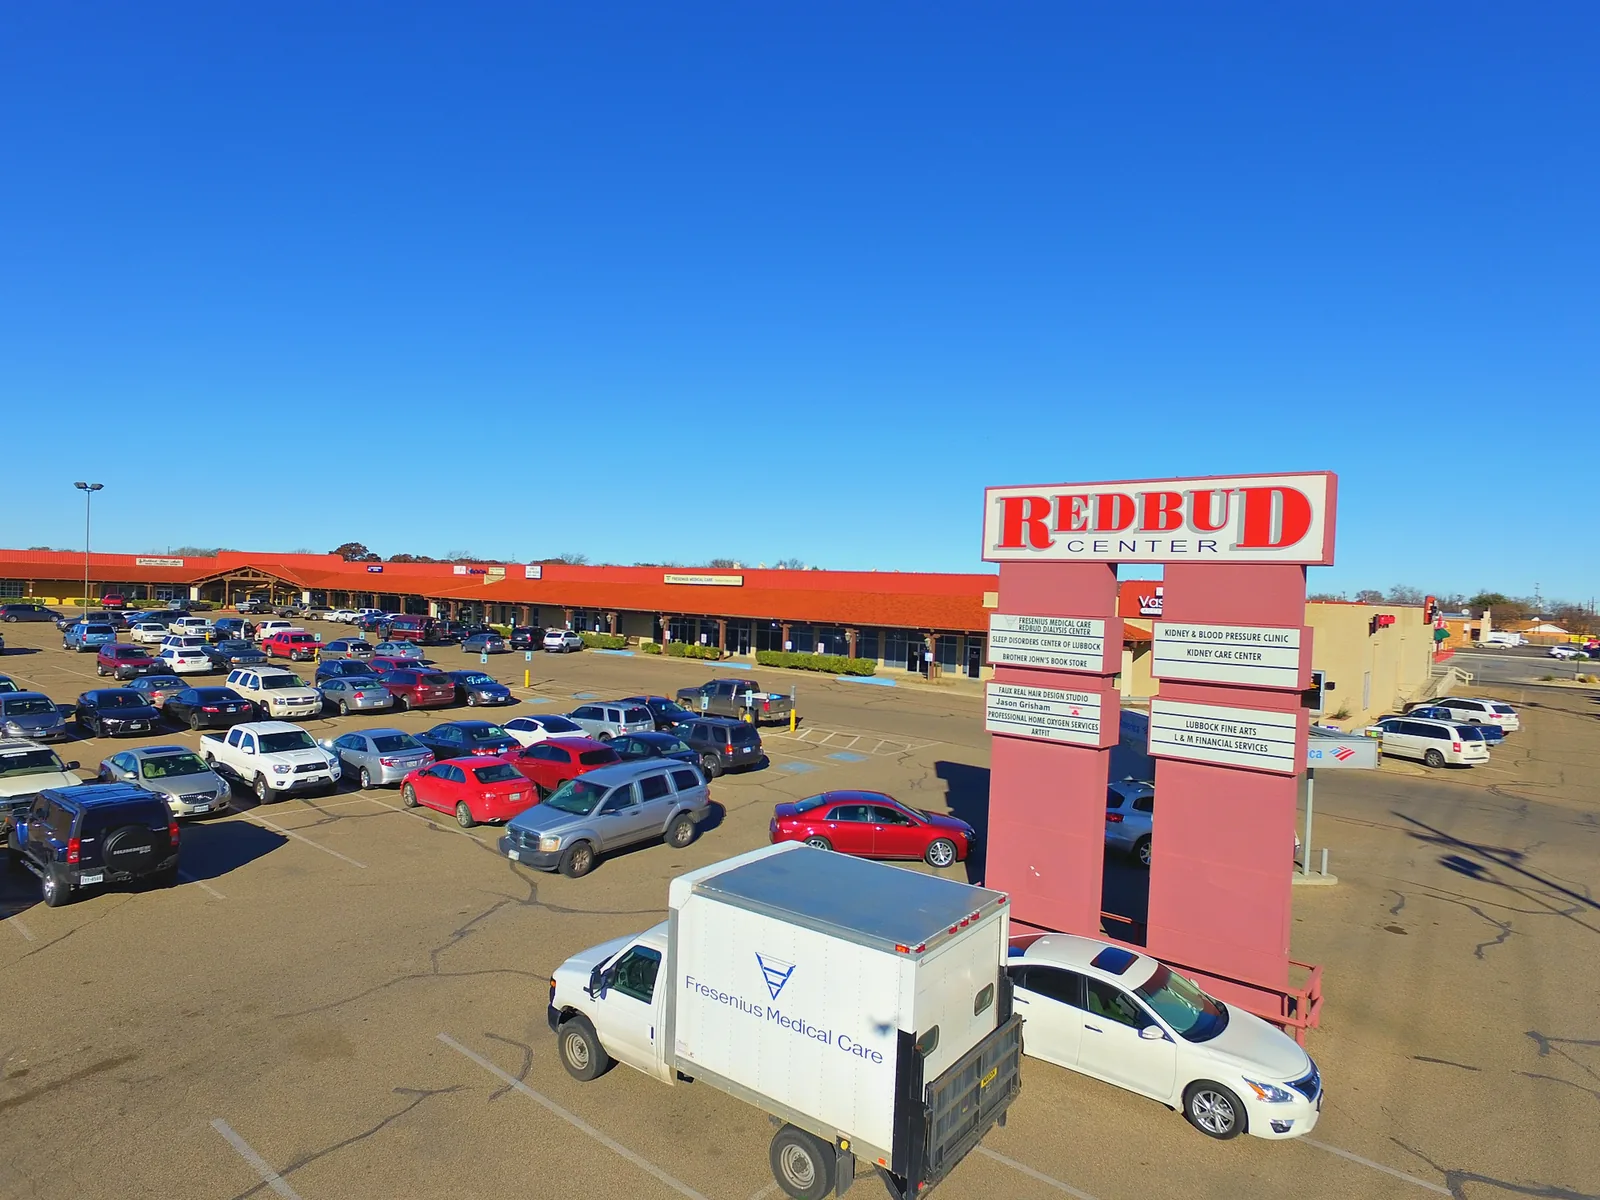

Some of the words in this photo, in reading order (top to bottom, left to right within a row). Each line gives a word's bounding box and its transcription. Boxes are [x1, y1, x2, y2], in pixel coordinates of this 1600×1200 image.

[993, 486, 1313, 552] REDBUD
[1067, 539, 1218, 553] CENTER
[1019, 617, 1048, 625] FRESENIUS
[1050, 619, 1074, 627] MEDICAL
[1019, 624, 1042, 632] REDBUD
[1043, 626, 1067, 634] DIALYSIS
[1164, 629, 1190, 638] KIDNEY
[1199, 631, 1223, 640] BLOOD
[1225, 632, 1261, 642] PRESSURE
[1263, 634, 1289, 643] CLINIC
[1009, 637, 1039, 646] DISORDERS
[1040, 638, 1062, 647] CENTER
[1072, 642, 1101, 650] LUBBOCK
[1002, 654, 1027, 662] BROTHER
[1028, 655, 1050, 664] JOHN'S
[1069, 660, 1087, 668] STORE
[1187, 649, 1212, 658] KIDNEY
[1214, 650, 1232, 659] CARE
[1234, 651, 1262, 661] CENTER
[999, 686, 1012, 695] FAUX
[1014, 688, 1026, 696] REAL
[1028, 690, 1041, 698] HAIR
[1043, 692, 1064, 700] DESIGN
[1066, 694, 1088, 702] STUDIO
[996, 698, 1017, 707] Jason
[1019, 701, 1051, 711] Grisham
[988, 711, 1027, 722] PROFESSIONAL
[1029, 716, 1045, 724] HOME
[1047, 718, 1070, 728] OXYGEN
[1071, 721, 1099, 731] SERVICES
[1186, 720, 1219, 731] LUBBOCK
[1221, 724, 1238, 733] FINE
[1239, 726, 1257, 736] ARTS
[1031, 728, 1050, 737] ARTFIT
[1174, 733, 1178, 741] L
[1179, 734, 1186, 742] &
[1187, 735, 1194, 743] M
[1195, 736, 1232, 748] FINANCIAL
[1234, 740, 1268, 752] SERVICES
[1308, 750, 1322, 759] ca
[686, 975, 763, 1018] Fresenius
[766, 1006, 832, 1045] Medical
[838, 1034, 883, 1064] Care
